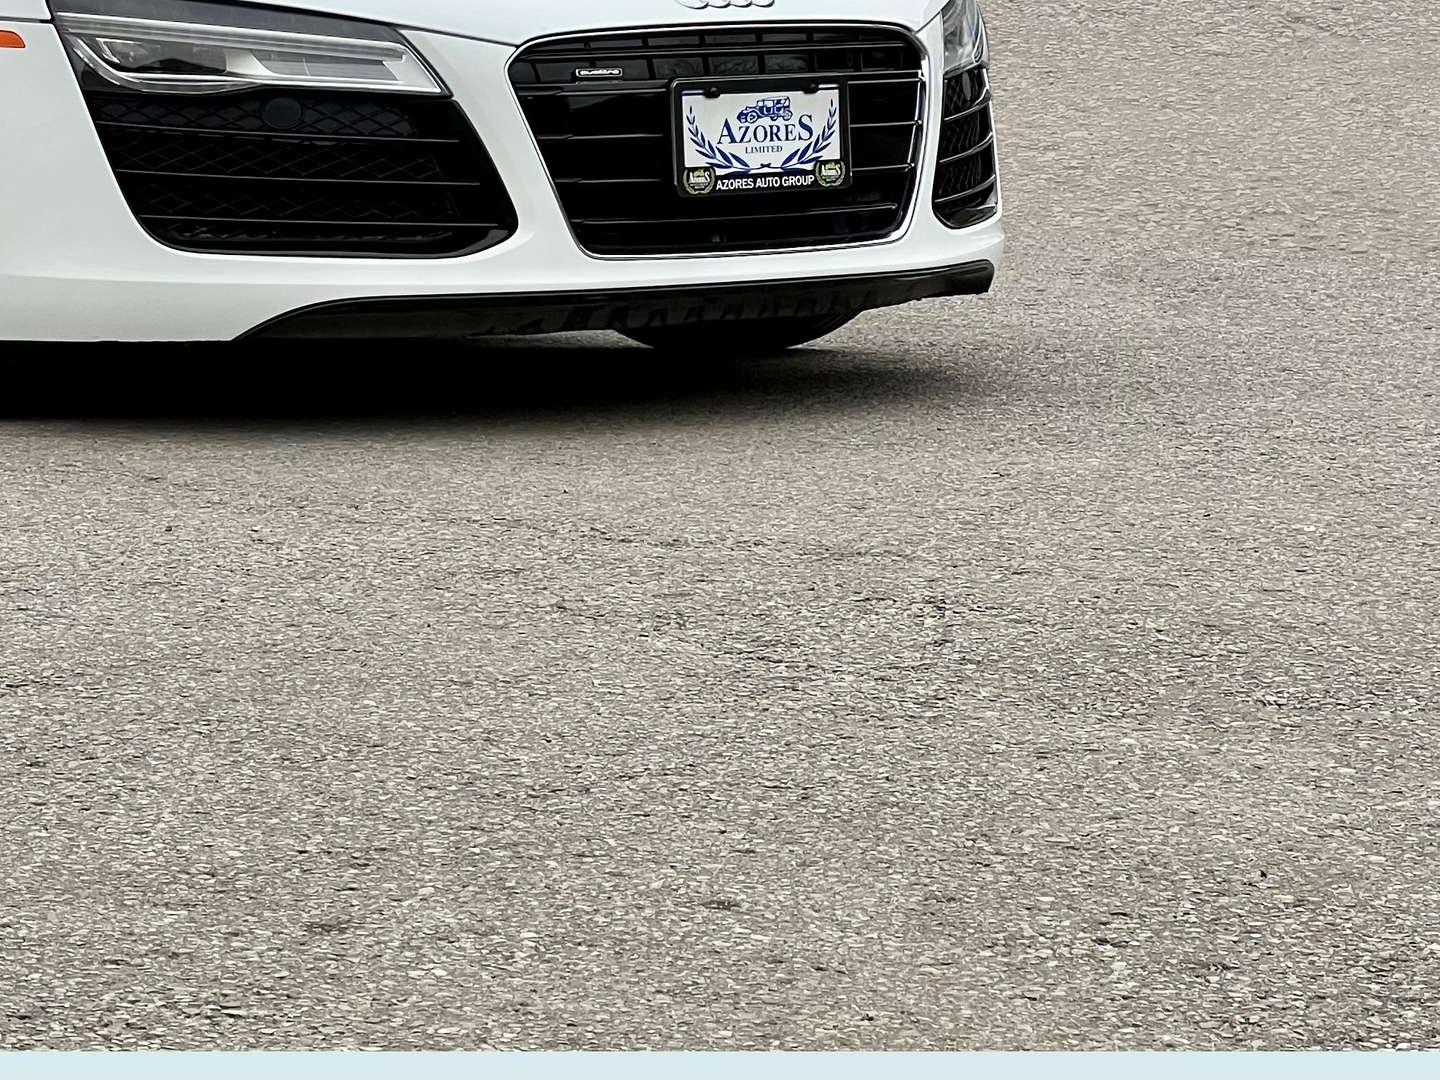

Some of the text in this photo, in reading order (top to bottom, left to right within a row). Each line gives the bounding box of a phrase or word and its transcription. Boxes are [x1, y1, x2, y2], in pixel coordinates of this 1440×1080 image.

[716, 113, 814, 145] AZORES
[744, 145, 783, 155] LIMITED
[715, 178, 754, 190] AZORES
[755, 176, 780, 188] AUTO
[782, 174, 815, 187] GROUP
